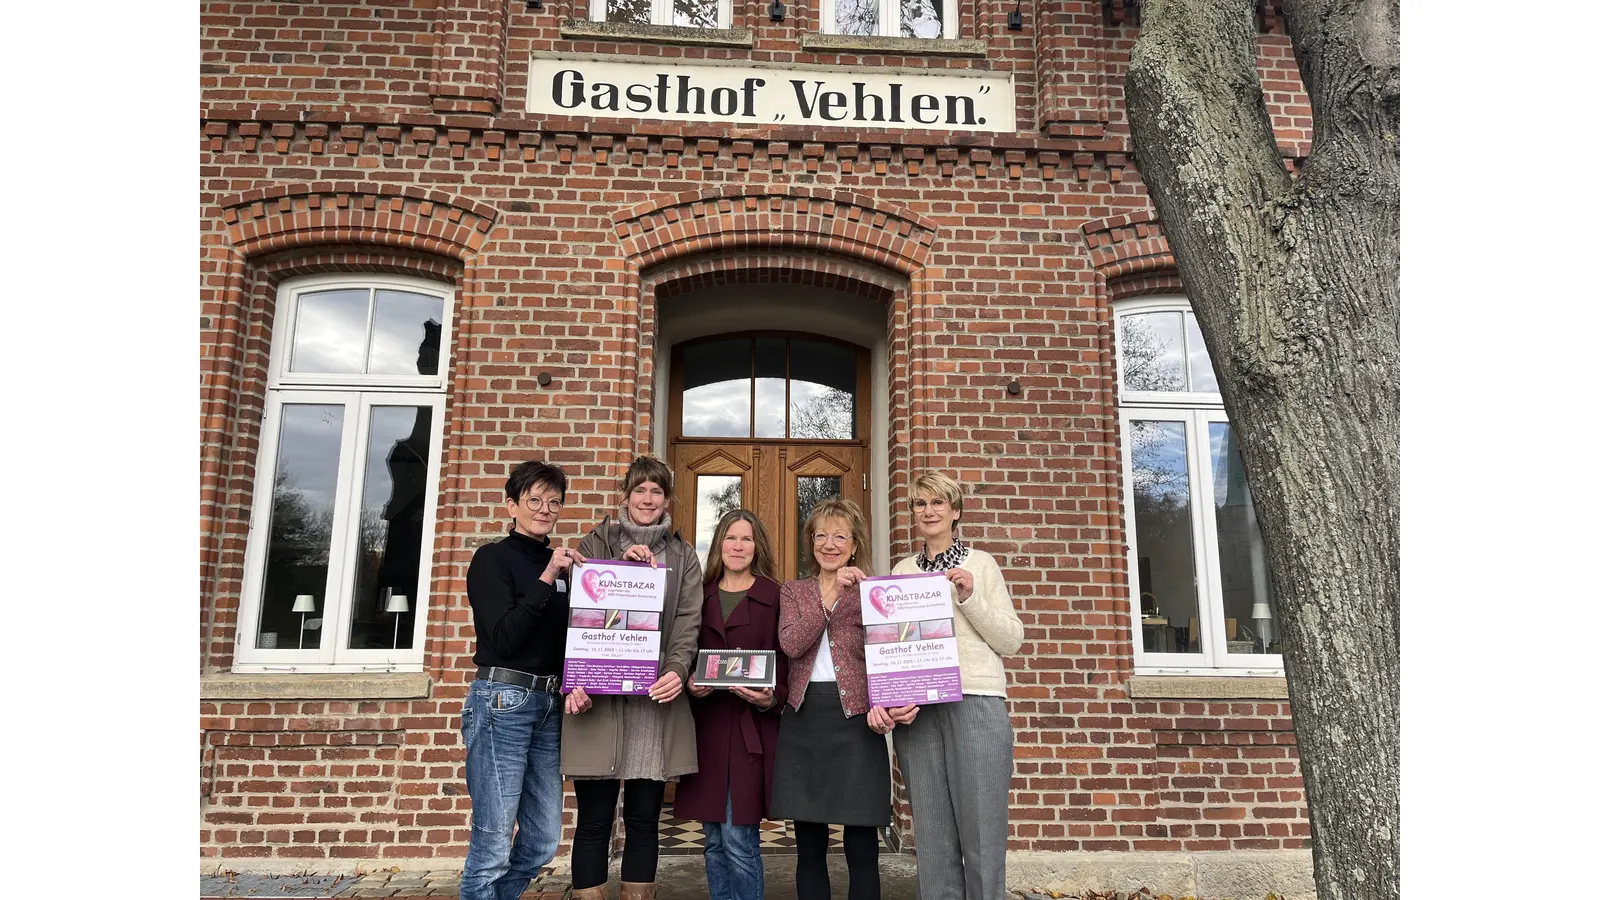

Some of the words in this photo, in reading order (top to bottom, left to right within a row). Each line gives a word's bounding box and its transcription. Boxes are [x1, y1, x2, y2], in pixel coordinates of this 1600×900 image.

[551, 69, 765, 118] Gasthof
[599, 579, 655, 590] KUNSTBAZAR
[886, 590, 942, 602] KUNSTBAZAR
[581, 631, 616, 641] Gasthof
[620, 633, 648, 642] Vehlen
[879, 644, 912, 655] Gasthof
[916, 642, 944, 652] Vehlen
